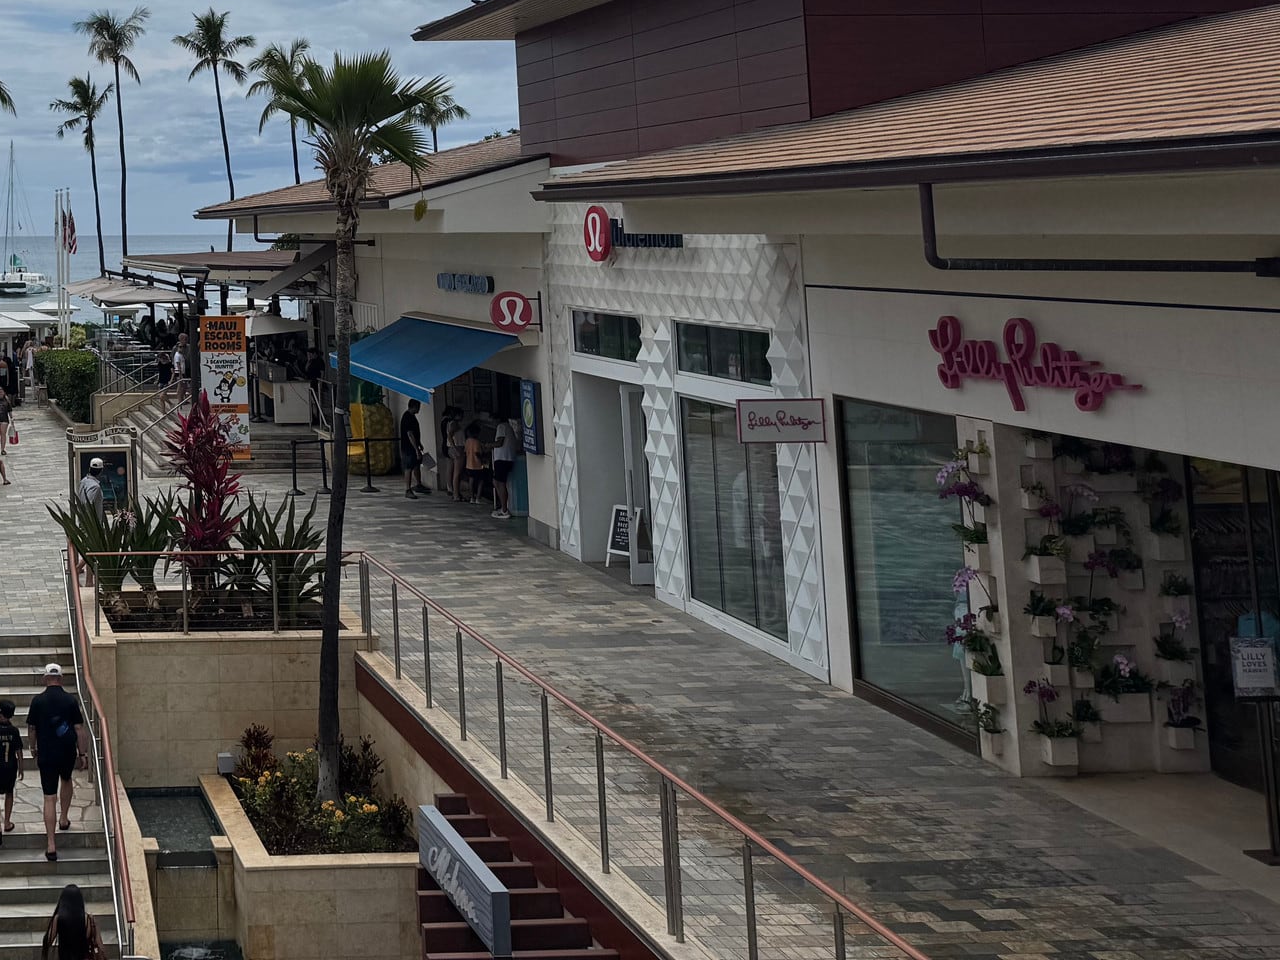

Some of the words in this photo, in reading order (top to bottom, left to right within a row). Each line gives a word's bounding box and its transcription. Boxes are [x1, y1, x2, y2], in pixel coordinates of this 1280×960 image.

[609, 218, 684, 248] ululemon
[209, 321, 237, 330] MAUI
[204, 331, 242, 340] ESCAPE
[205, 341, 242, 350] ROOMS
[928, 316, 1027, 411] Lilly
[1003, 318, 1143, 412] Pulitzer
[748, 411, 781, 432] Lilly
[775, 410, 821, 430] Pulitzer
[1241, 652, 1266, 660] LILLY
